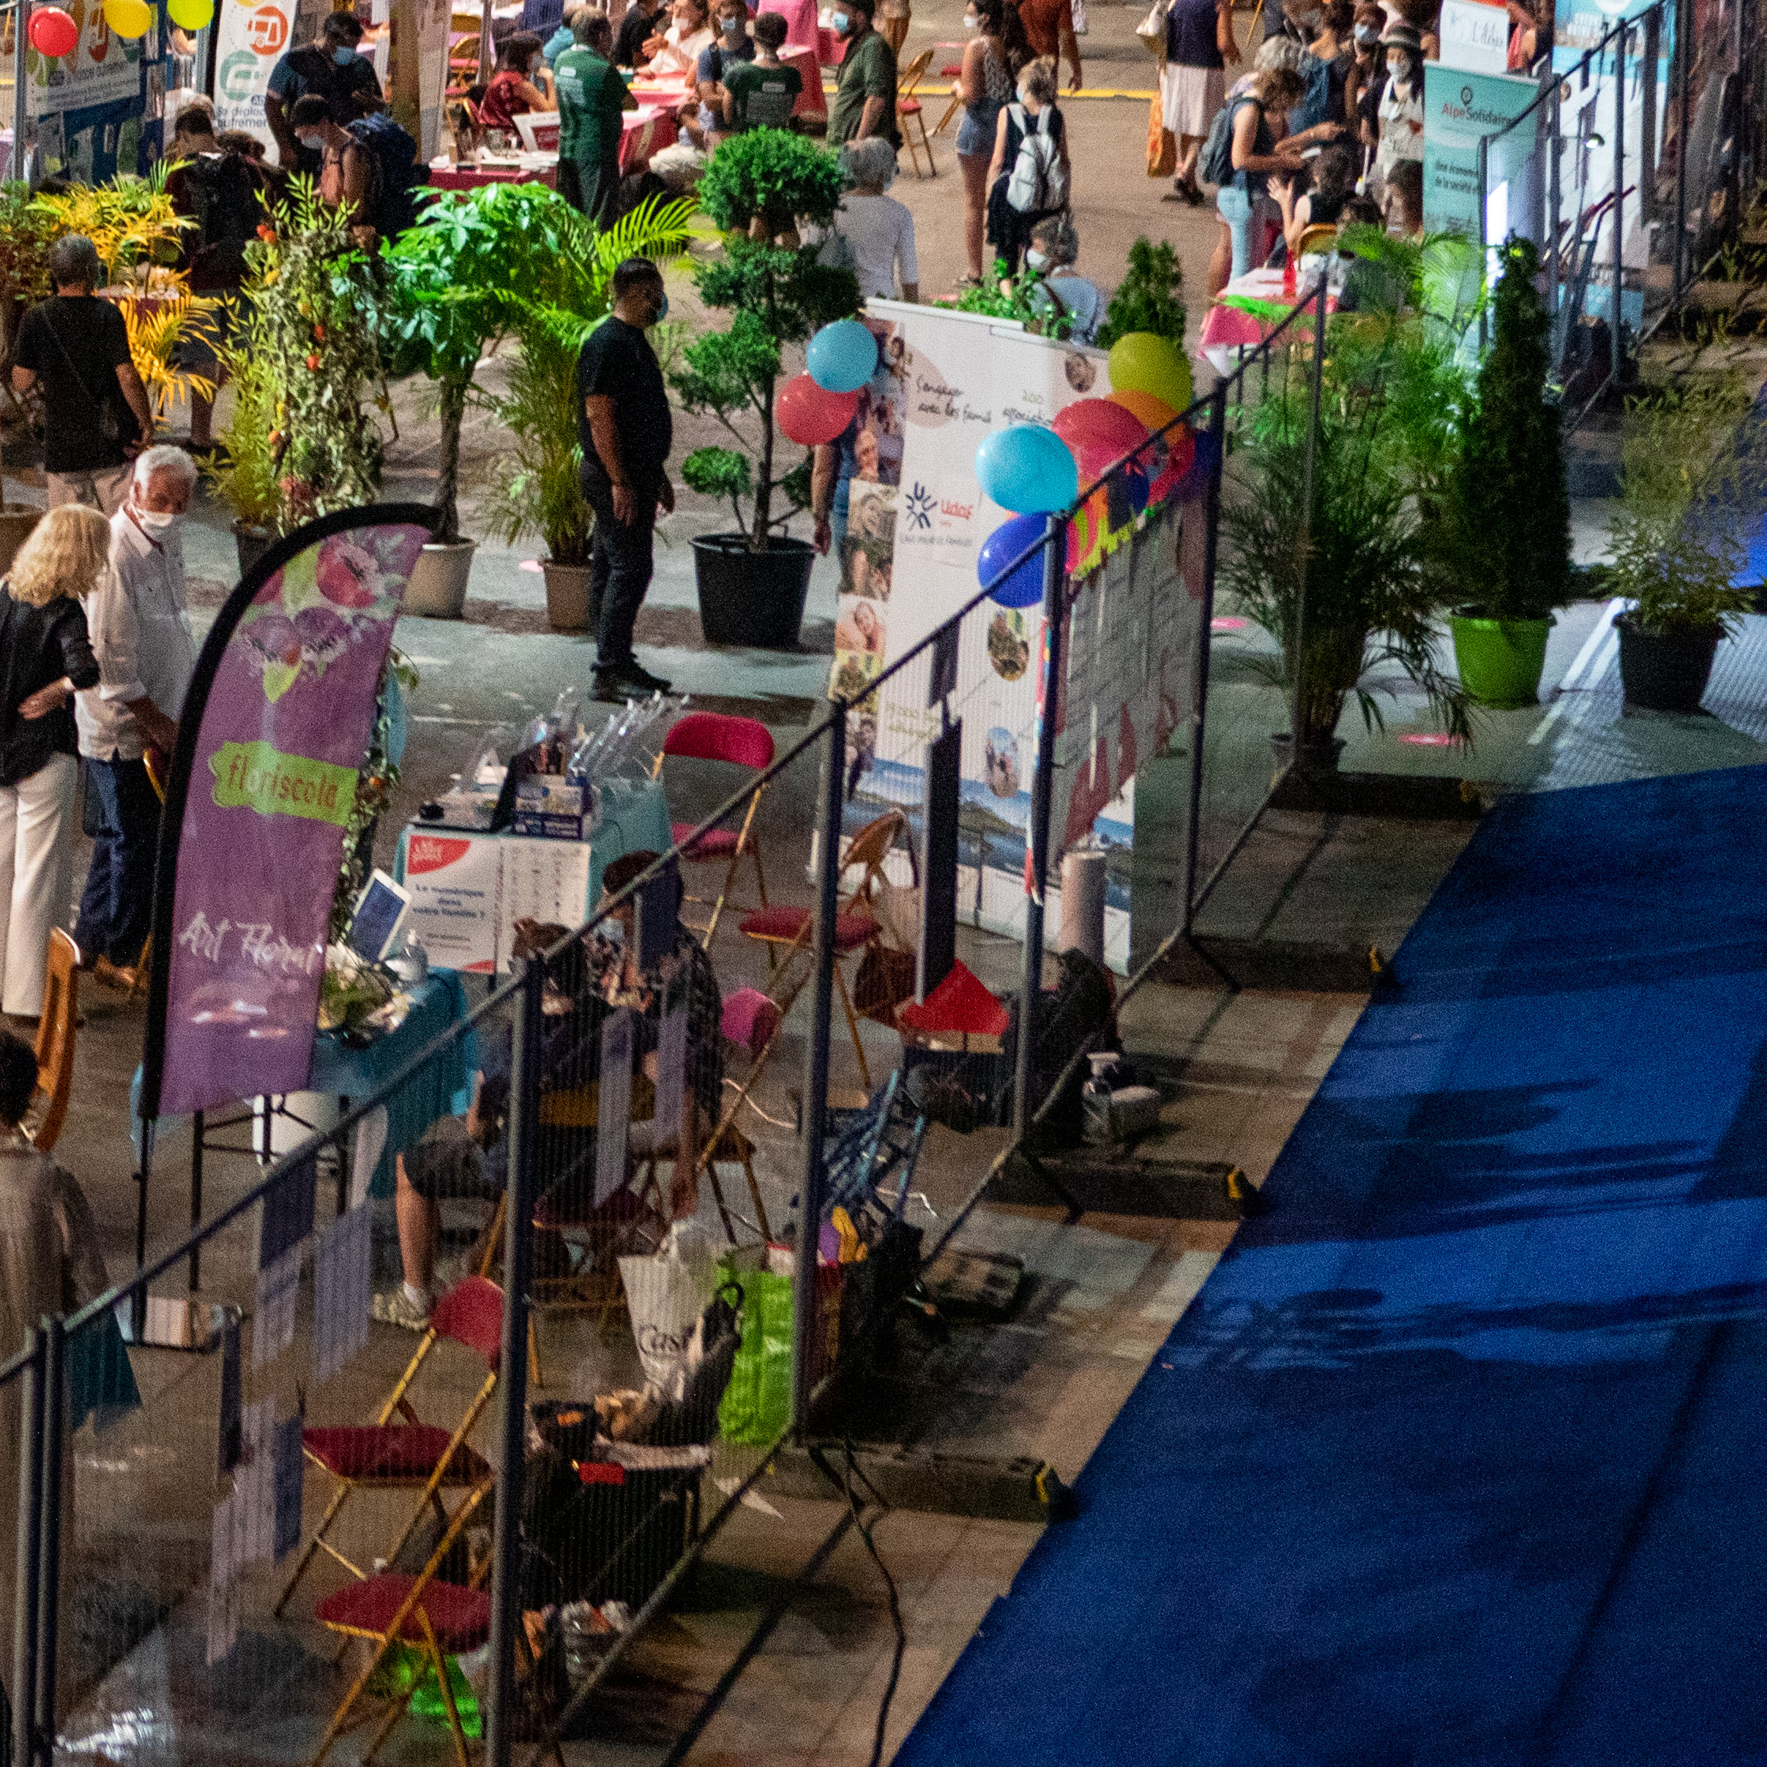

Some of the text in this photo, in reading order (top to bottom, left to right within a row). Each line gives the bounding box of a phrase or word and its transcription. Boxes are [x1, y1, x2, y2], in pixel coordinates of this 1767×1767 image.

[941, 499, 974, 521] Udaf
[228, 752, 339, 813] floriscola
[178, 911, 326, 974] Art Floral
